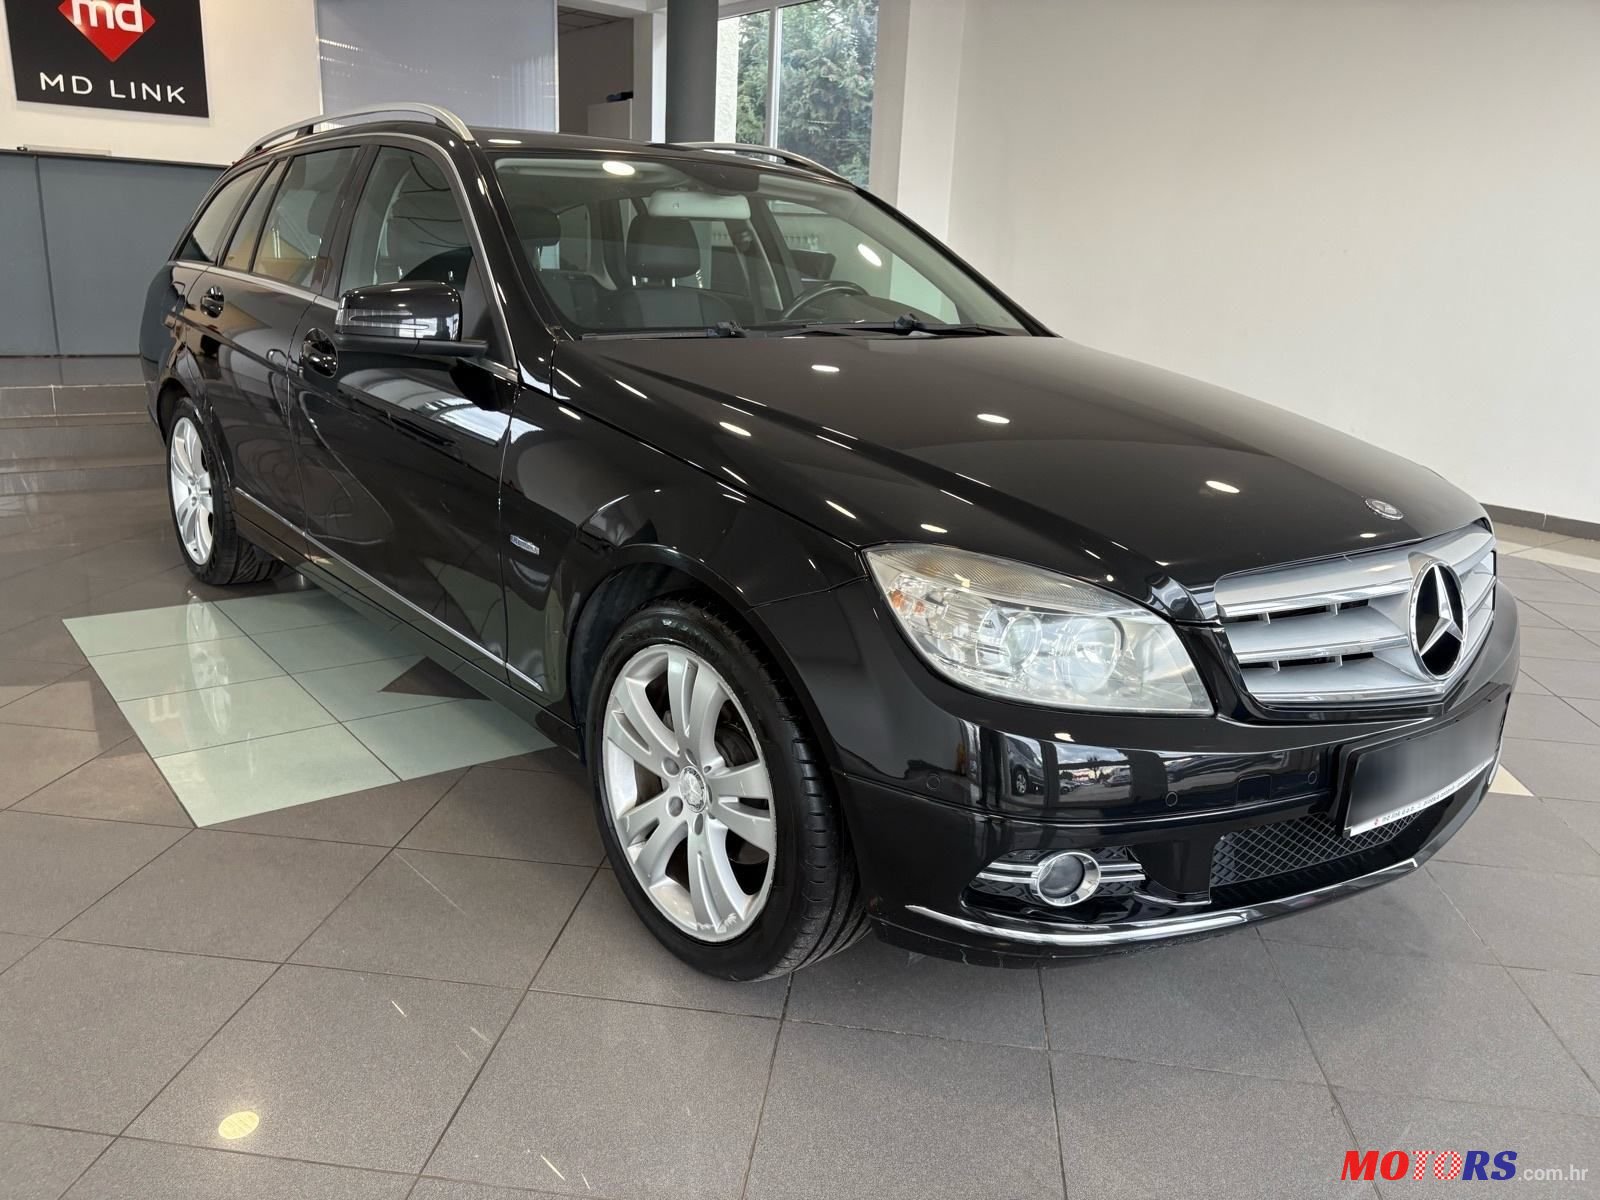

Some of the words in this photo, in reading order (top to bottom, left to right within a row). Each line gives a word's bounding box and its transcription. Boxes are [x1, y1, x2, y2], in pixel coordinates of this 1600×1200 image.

[70, 0, 144, 33] md
[39, 72, 93, 95] MD
[109, 79, 186, 104] LINK
